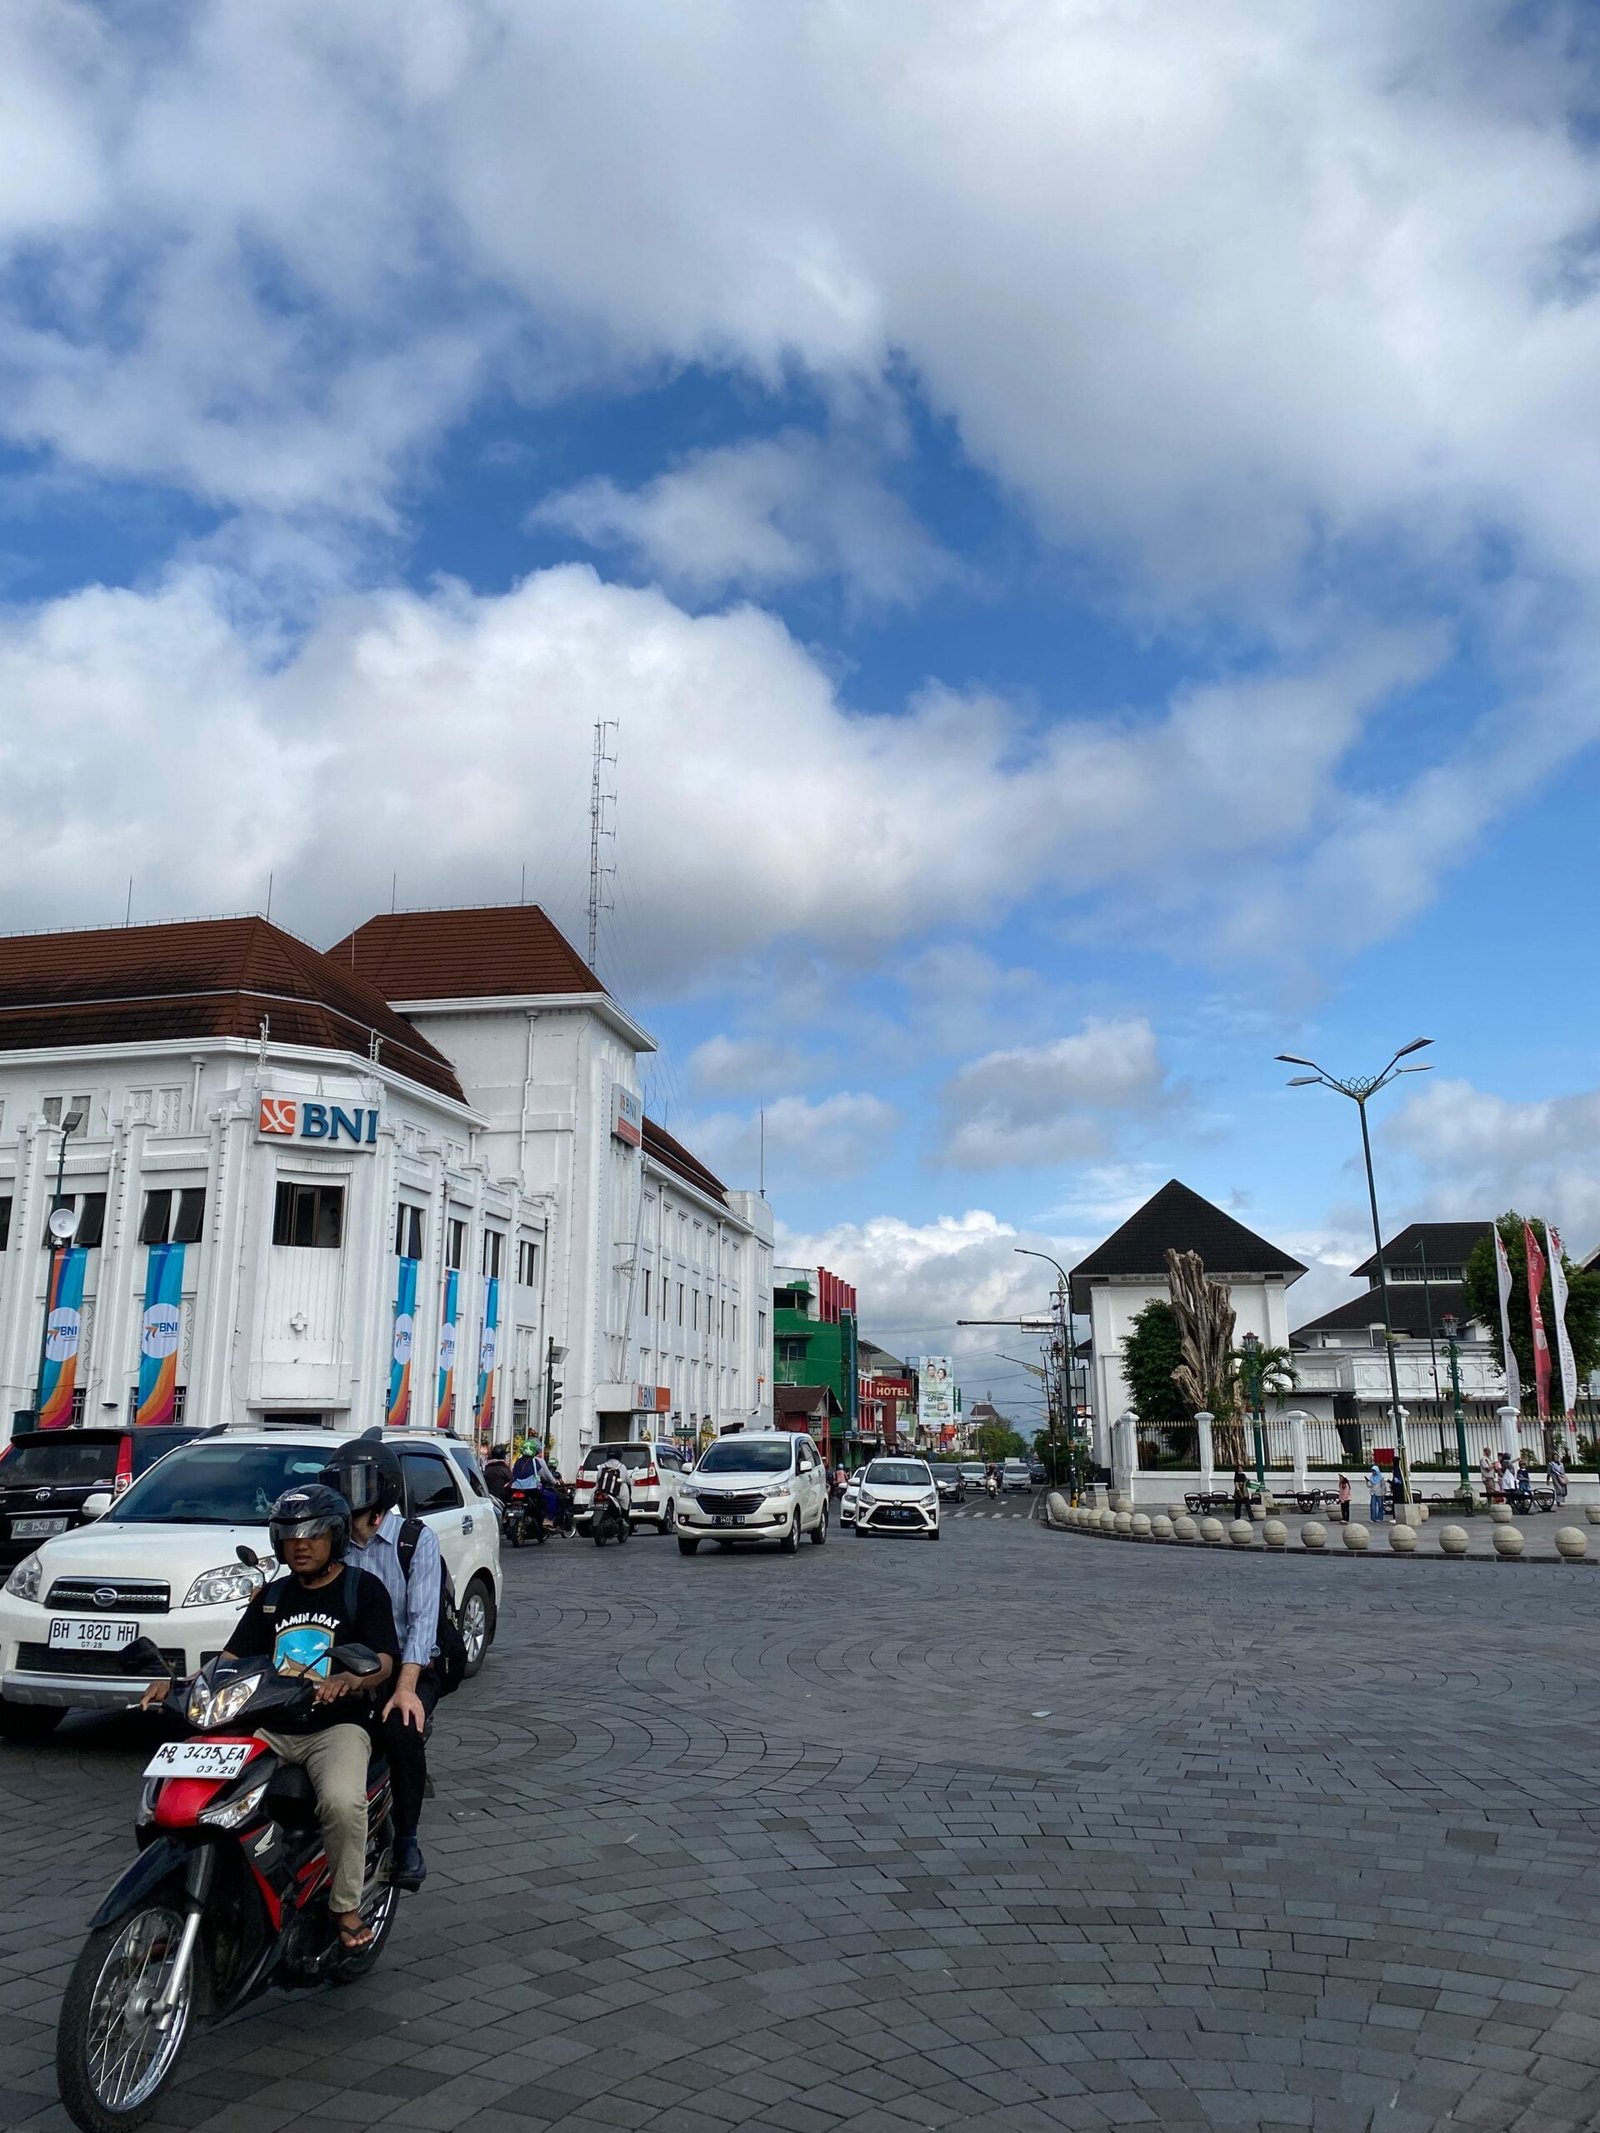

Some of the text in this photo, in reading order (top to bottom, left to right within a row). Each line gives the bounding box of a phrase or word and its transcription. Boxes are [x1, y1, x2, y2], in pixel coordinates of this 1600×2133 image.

[300, 1102, 379, 1143] BNI
[60, 1325, 78, 1336] BNI
[159, 1322, 178, 1333] BNI
[876, 1387, 910, 1397] HOTEL
[274, 1612, 341, 1633] LAMIN ADAT
[53, 1622, 134, 1642] BH 1820 HH
[156, 1745, 246, 1761] AB 3435 EA
